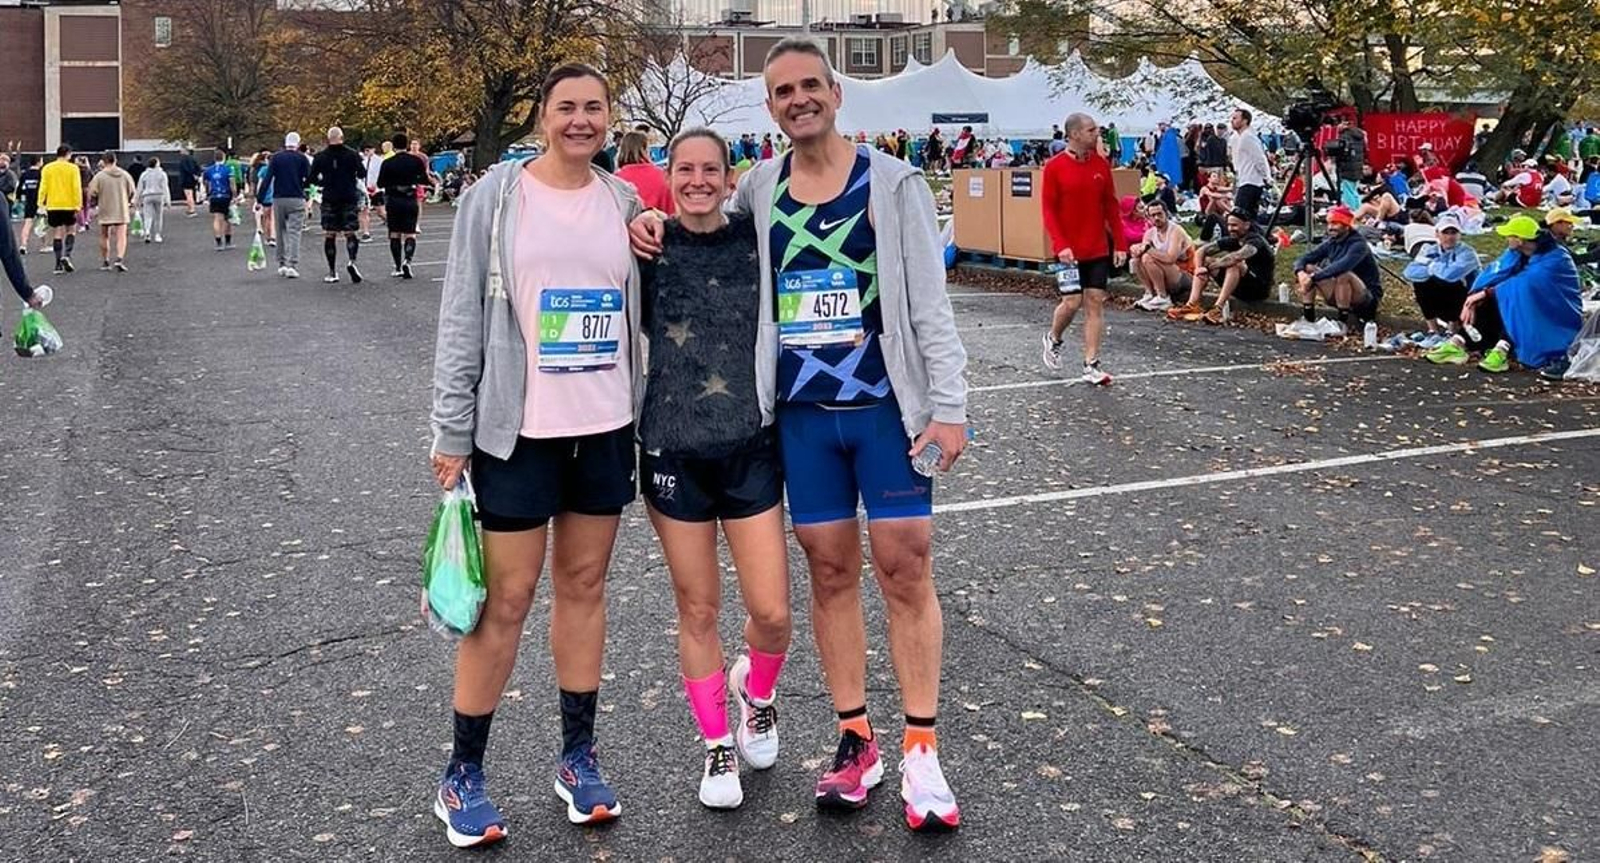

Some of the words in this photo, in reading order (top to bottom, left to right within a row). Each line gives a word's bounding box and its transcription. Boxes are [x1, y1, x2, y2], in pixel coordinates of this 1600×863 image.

[1395, 120, 1446, 133] HAPPY
[813, 292, 849, 318] 4572
[582, 314, 612, 339] 8717
[652, 471, 676, 488] NYC
